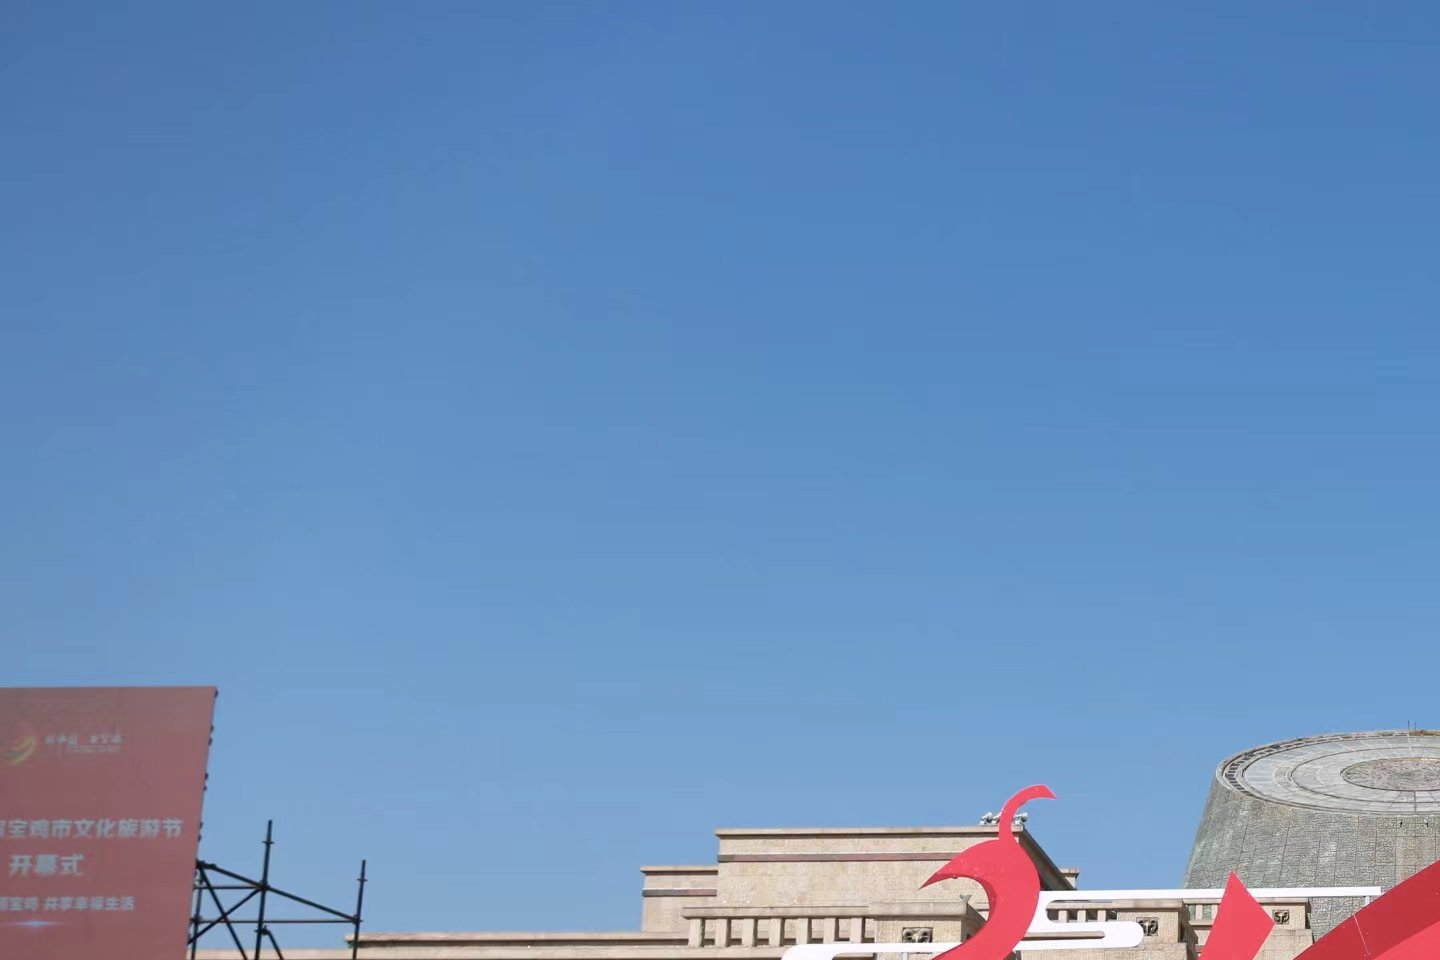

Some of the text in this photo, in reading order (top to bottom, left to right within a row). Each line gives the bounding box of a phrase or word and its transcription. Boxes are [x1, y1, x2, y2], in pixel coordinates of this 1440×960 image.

[0, 818, 183, 840] 宝鸡市文化旅游节
[9, 853, 84, 877] 开幕式
